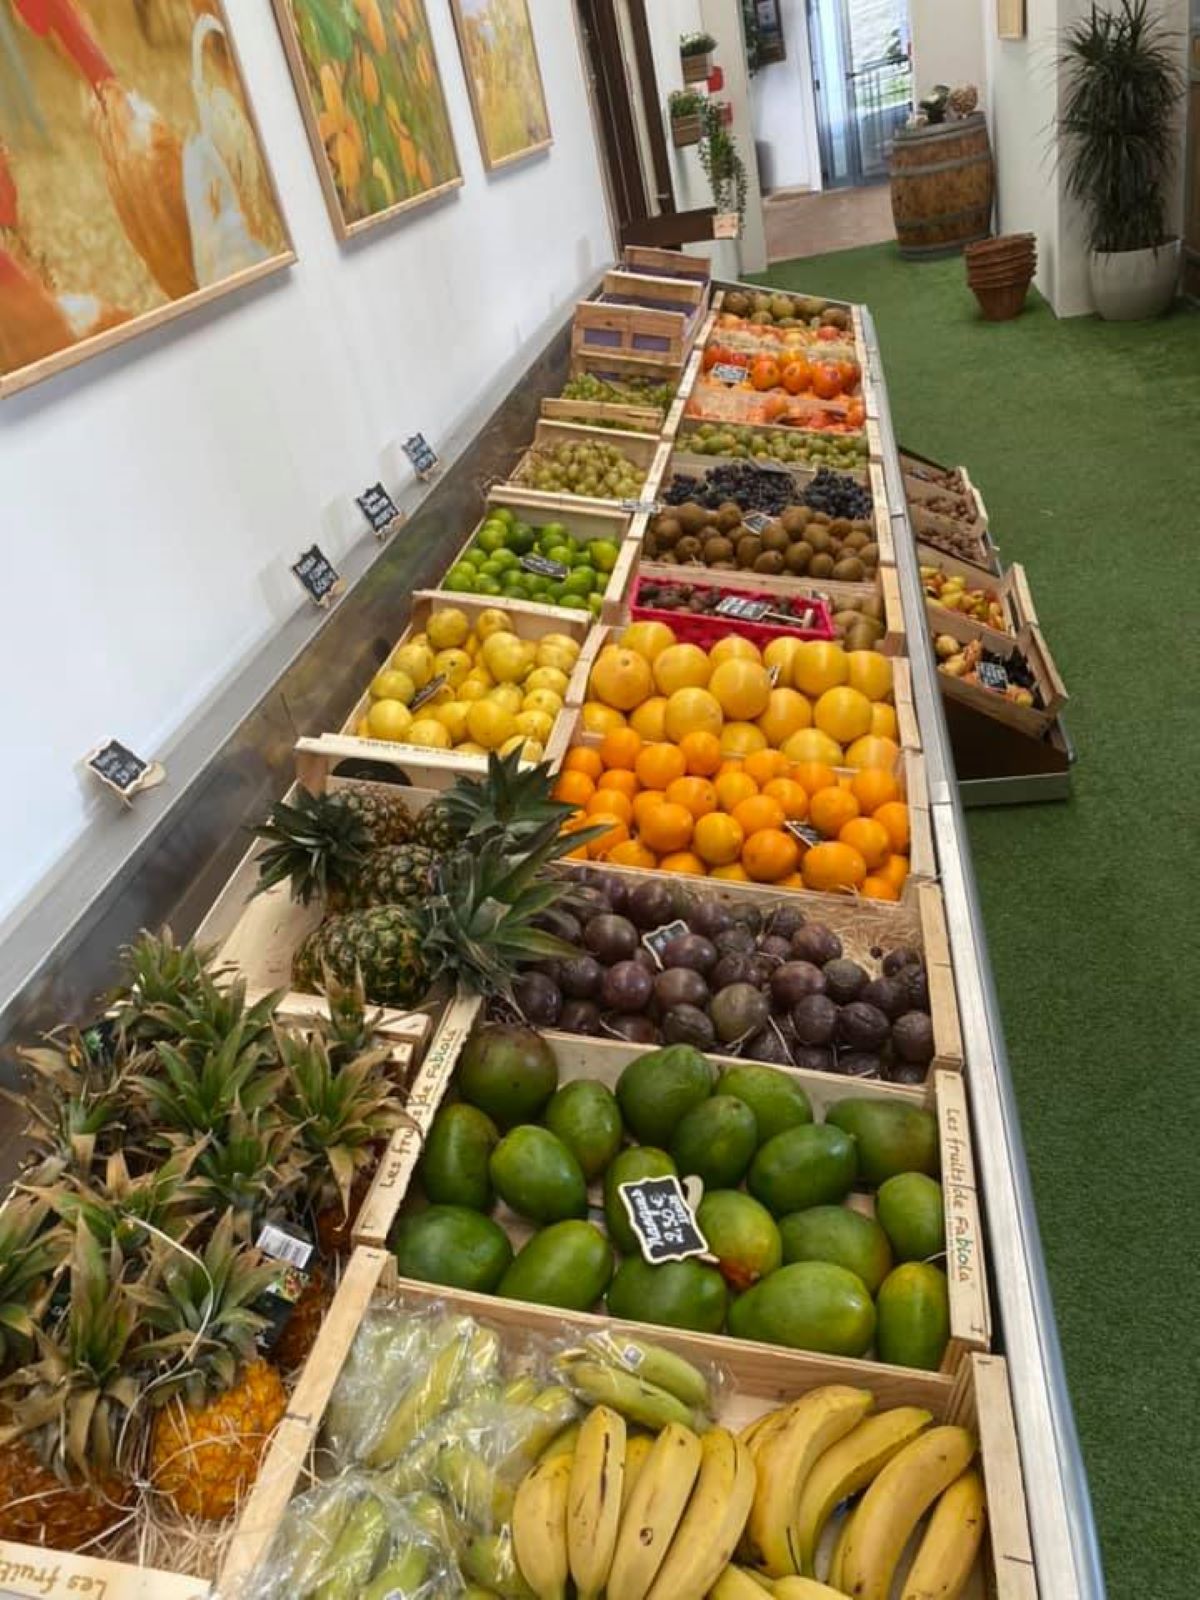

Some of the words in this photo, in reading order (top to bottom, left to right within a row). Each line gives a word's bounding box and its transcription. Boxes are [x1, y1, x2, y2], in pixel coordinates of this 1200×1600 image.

[946, 1108, 961, 1132] Les
[945, 1134, 968, 1183] fruits
[952, 1216, 975, 1283] Fabiola
[0, 1561, 61, 1594] fruit
[66, 1574, 108, 1600] Les
